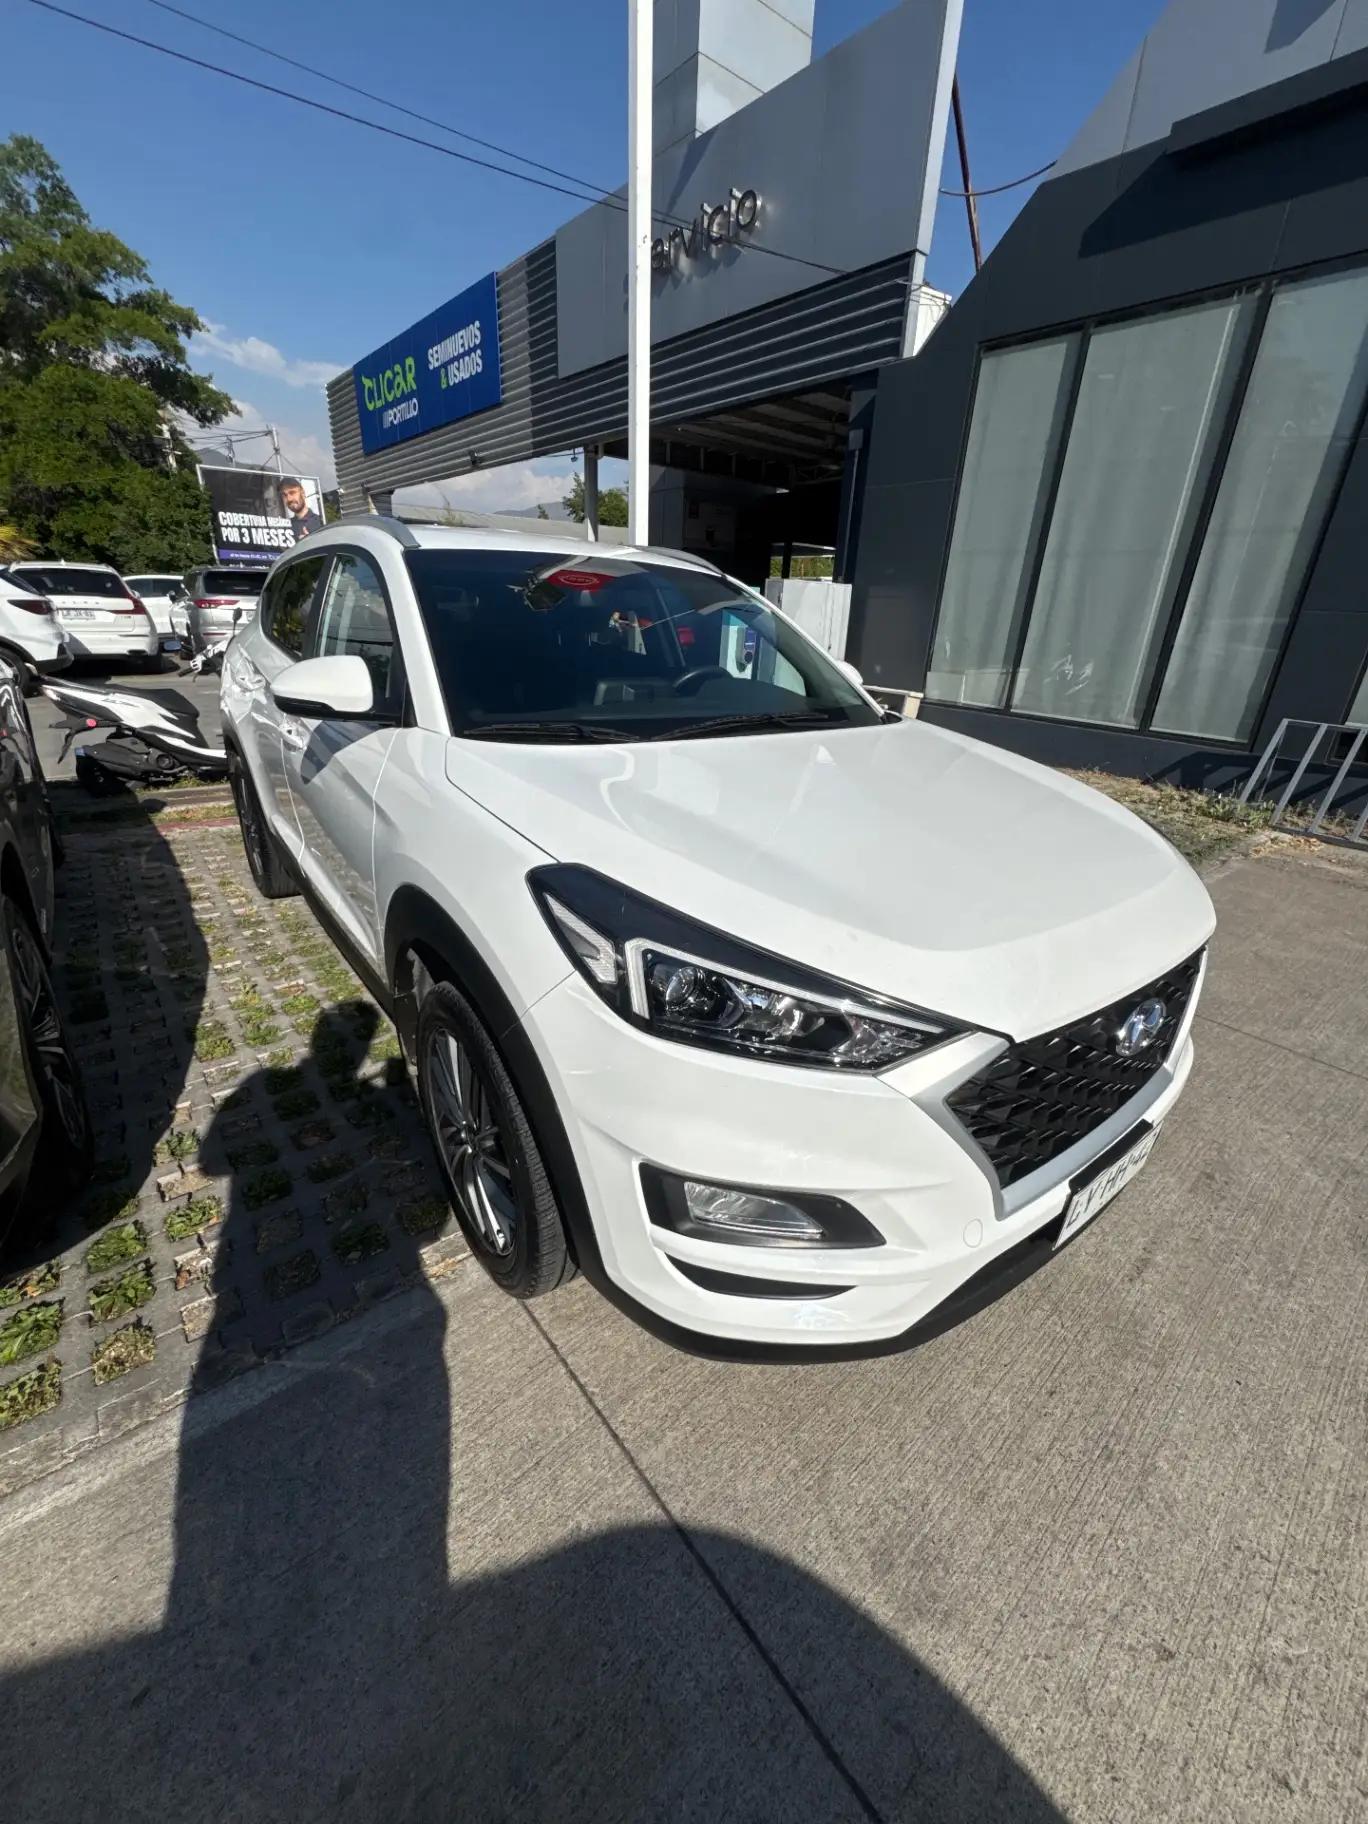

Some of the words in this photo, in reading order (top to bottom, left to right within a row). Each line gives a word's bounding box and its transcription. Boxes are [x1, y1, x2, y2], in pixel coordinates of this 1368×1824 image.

[651, 187, 759, 270] ervicio
[427, 320, 481, 370] SEMINUEVOS
[448, 349, 483, 386] USADOS
[387, 397, 419, 427] PORTILLO
[218, 511, 267, 527] COBERTURA
[221, 527, 240, 543] POR
[241, 529, 250, 544] 3
[251, 527, 296, 548] MESES
